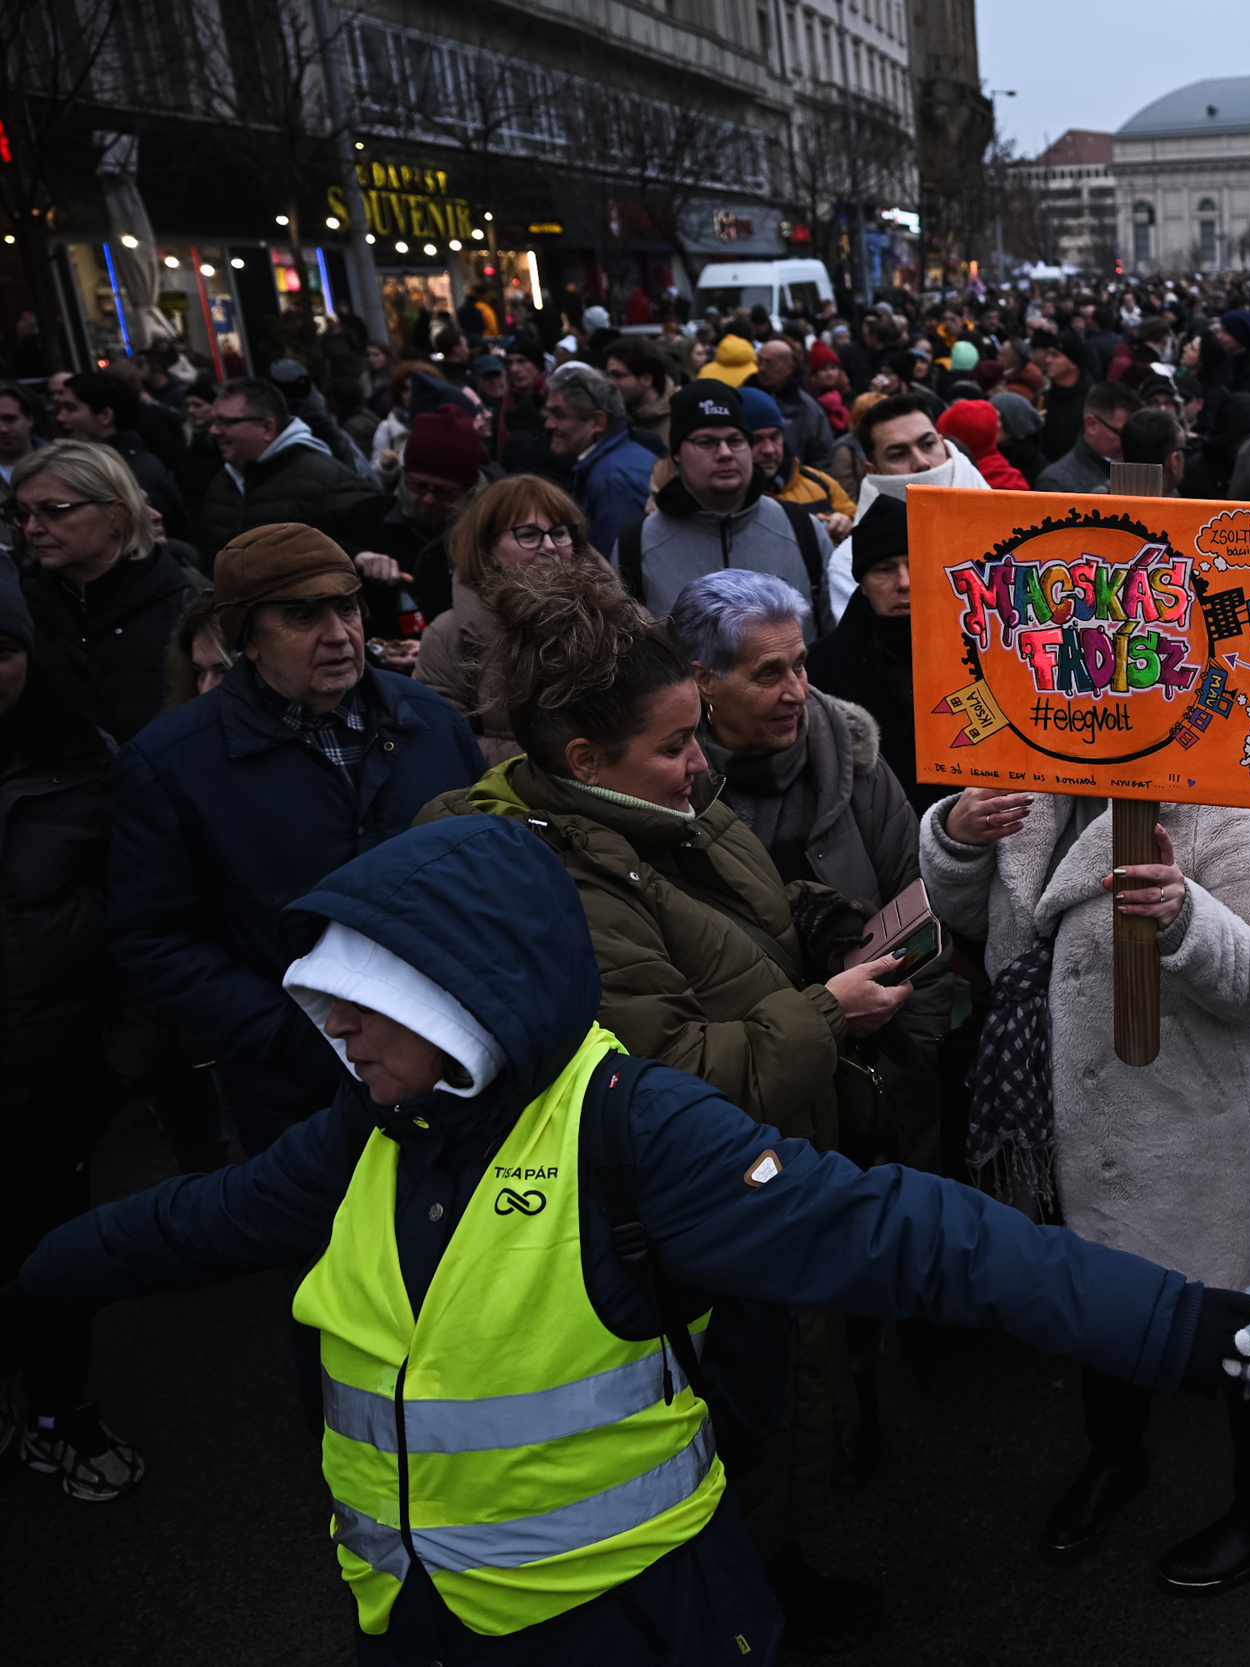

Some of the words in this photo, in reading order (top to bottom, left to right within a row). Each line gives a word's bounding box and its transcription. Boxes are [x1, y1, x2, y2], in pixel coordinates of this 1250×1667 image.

[945, 543, 1194, 651] MACSKÁS
[1017, 618, 1200, 702] FADÍSZ
[970, 768, 1000, 778] LENNE
[1008, 771, 1026, 781] EGY
